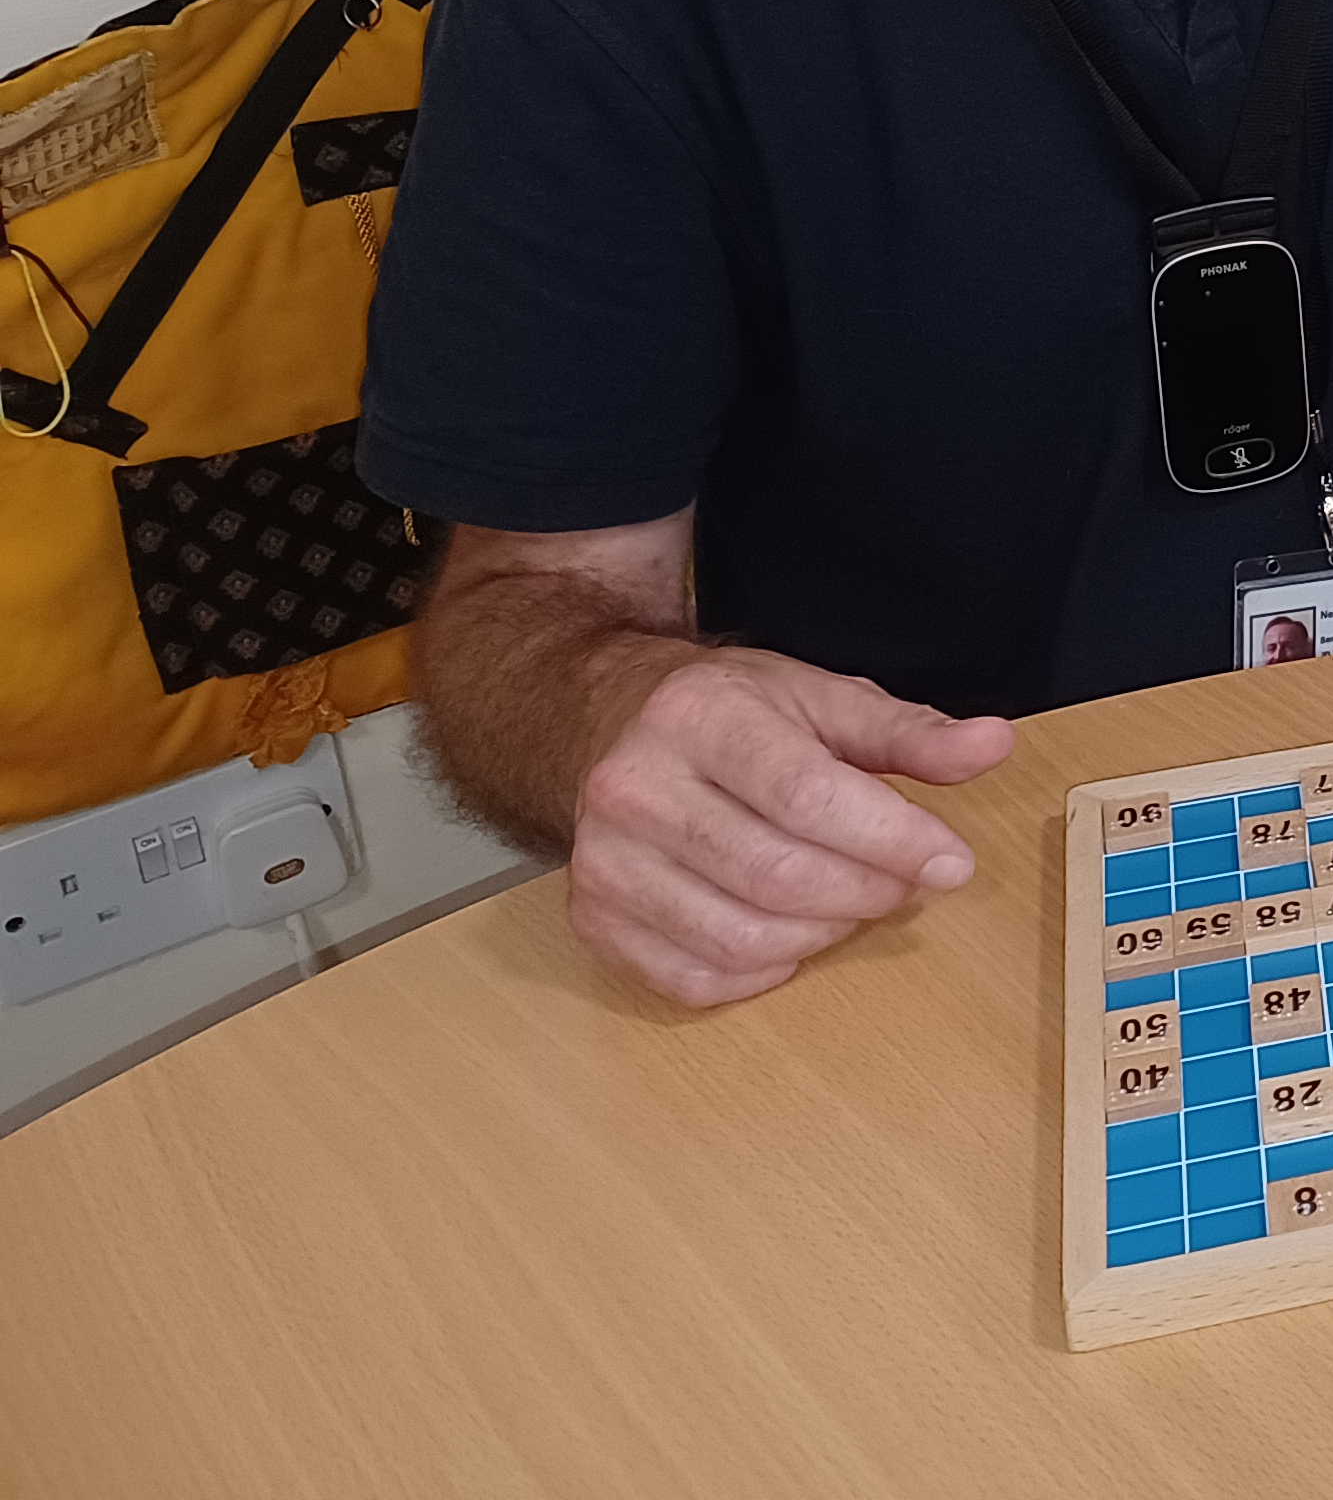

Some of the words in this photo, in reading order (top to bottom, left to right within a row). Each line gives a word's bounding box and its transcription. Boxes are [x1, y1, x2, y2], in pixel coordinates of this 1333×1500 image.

[1200, 260, 1248, 278] PHONAK
[1223, 423, 1251, 435] roger
[1117, 803, 1163, 828] 90
[139, 837, 157, 848] ON
[175, 824, 193, 835] ON
[1251, 820, 1296, 845] 78
[1186, 913, 1231, 940] 59
[1256, 901, 1301, 928] 58
[1117, 928, 1163, 955] 60
[1263, 988, 1312, 1016] 48
[1119, 1013, 1168, 1043] 50
[1119, 1064, 1171, 1095] 40
[1272, 1079, 1323, 1112] 28
[1293, 1186, 1318, 1217] 8
